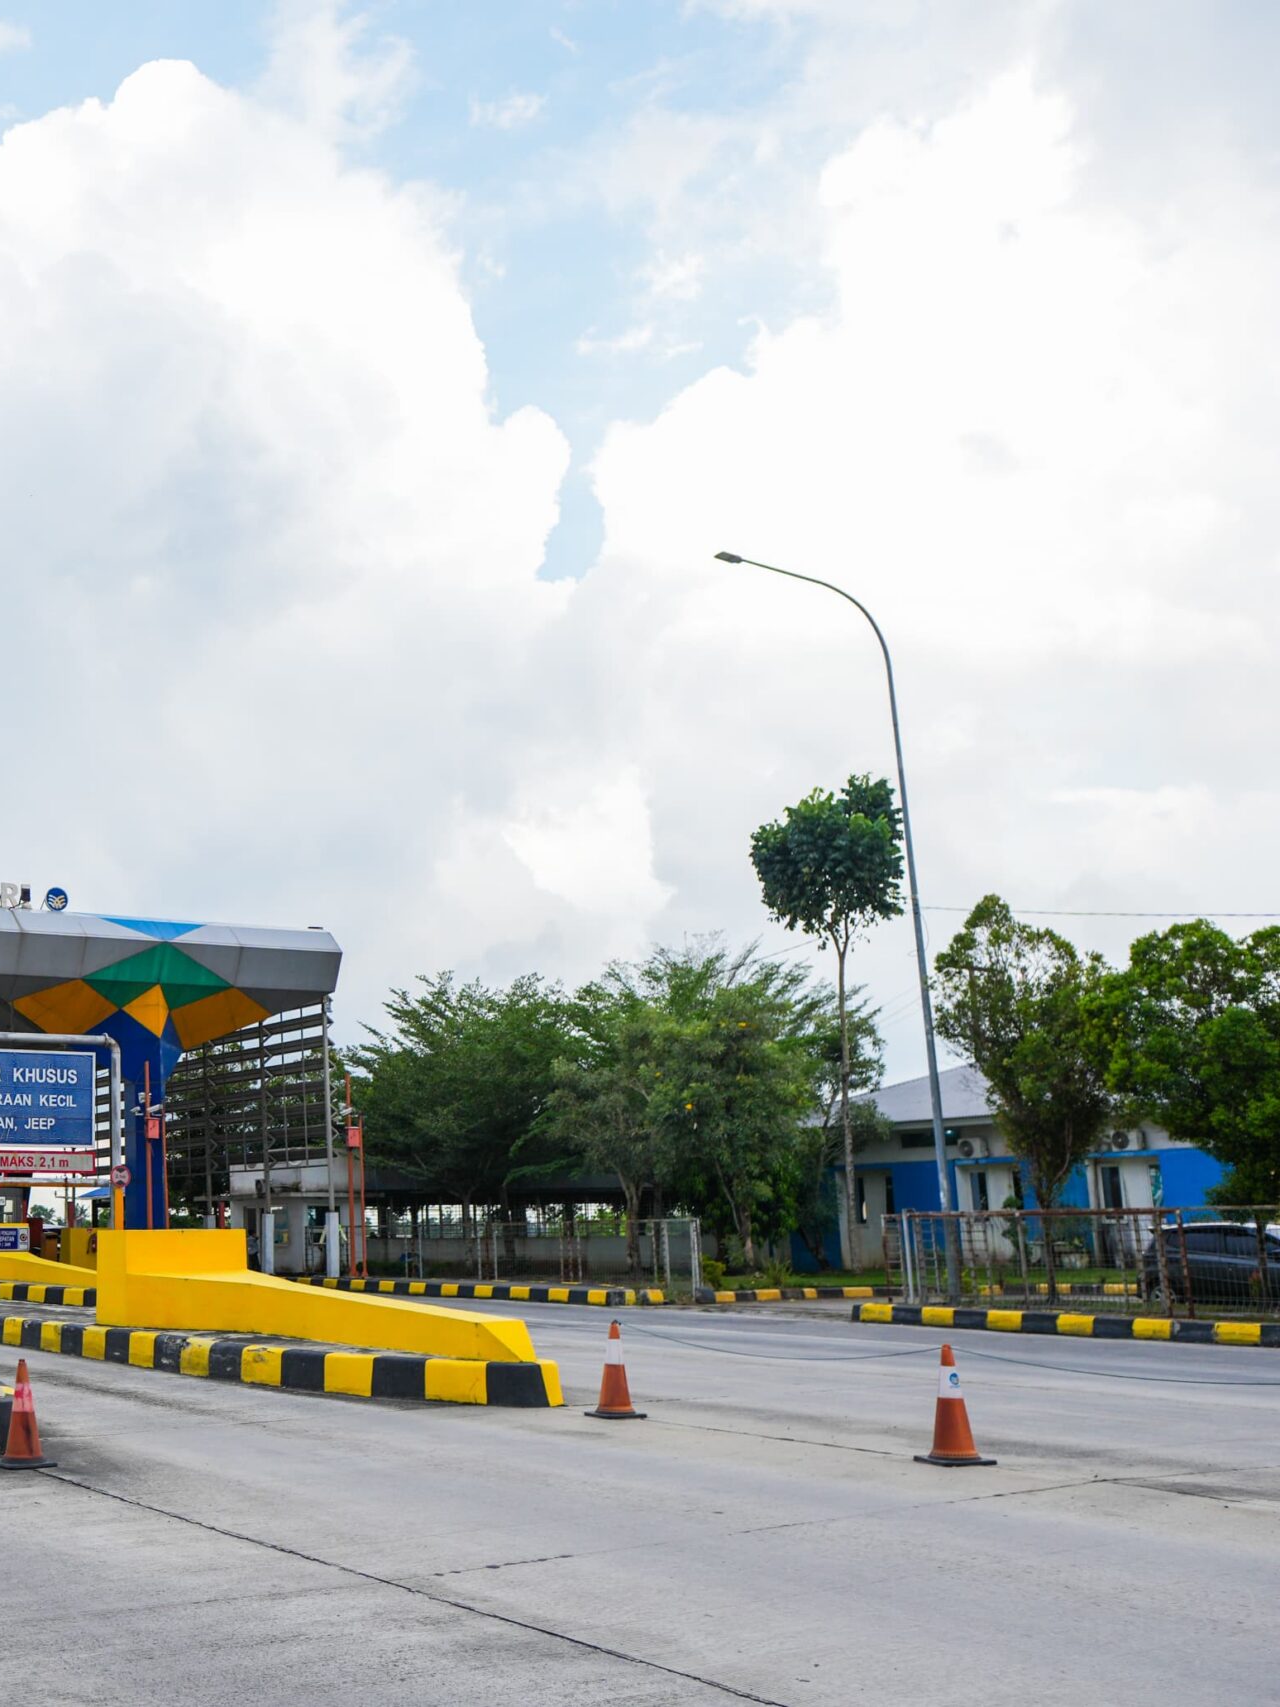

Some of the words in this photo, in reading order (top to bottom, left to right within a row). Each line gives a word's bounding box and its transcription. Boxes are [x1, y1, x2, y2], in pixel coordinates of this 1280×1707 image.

[13, 1067, 78, 1084] KHUSUS
[39, 1094, 77, 1108] KECIL
[24, 1117, 55, 1130] JEEP
[0, 1156, 37, 1168] MAKS.
[39, 1156, 55, 1169] 2,1
[58, 1158, 69, 1168] m
